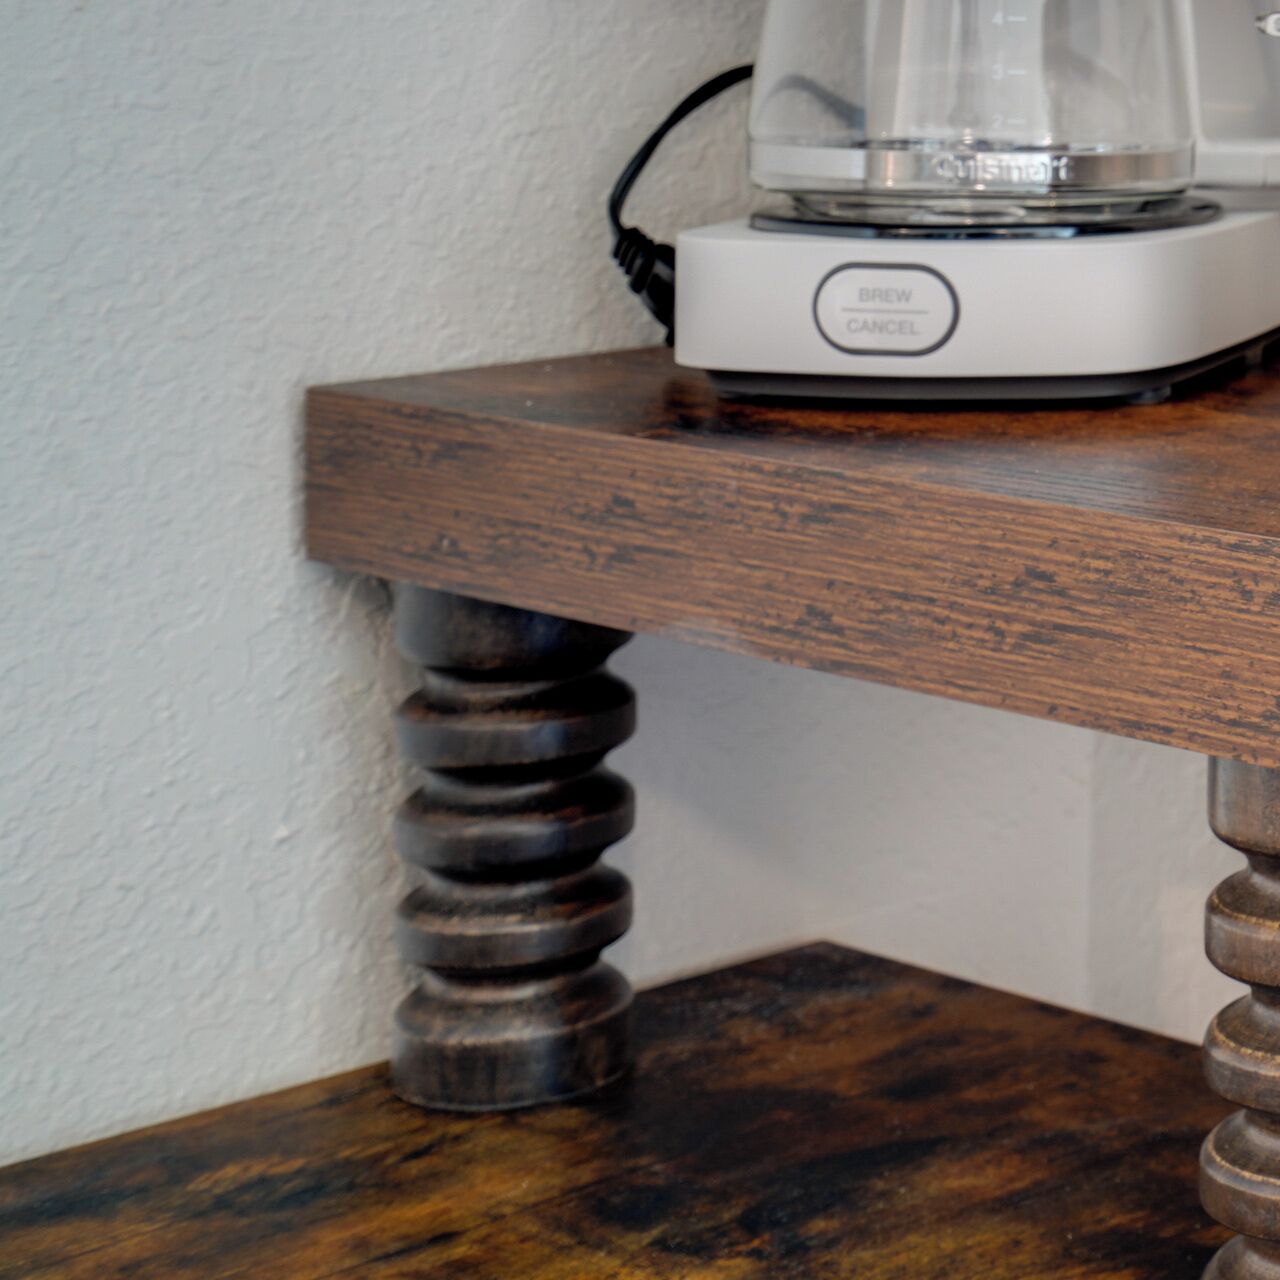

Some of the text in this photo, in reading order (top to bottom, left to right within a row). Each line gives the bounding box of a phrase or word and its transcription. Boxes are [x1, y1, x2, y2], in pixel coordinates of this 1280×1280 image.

[991, 10, 1004, 26] 4
[991, 63, 1004, 80] 3
[931, 153, 1073, 184] Cuisinart
[858, 287, 914, 304] BREW
[846, 318, 921, 336] CANCEL
